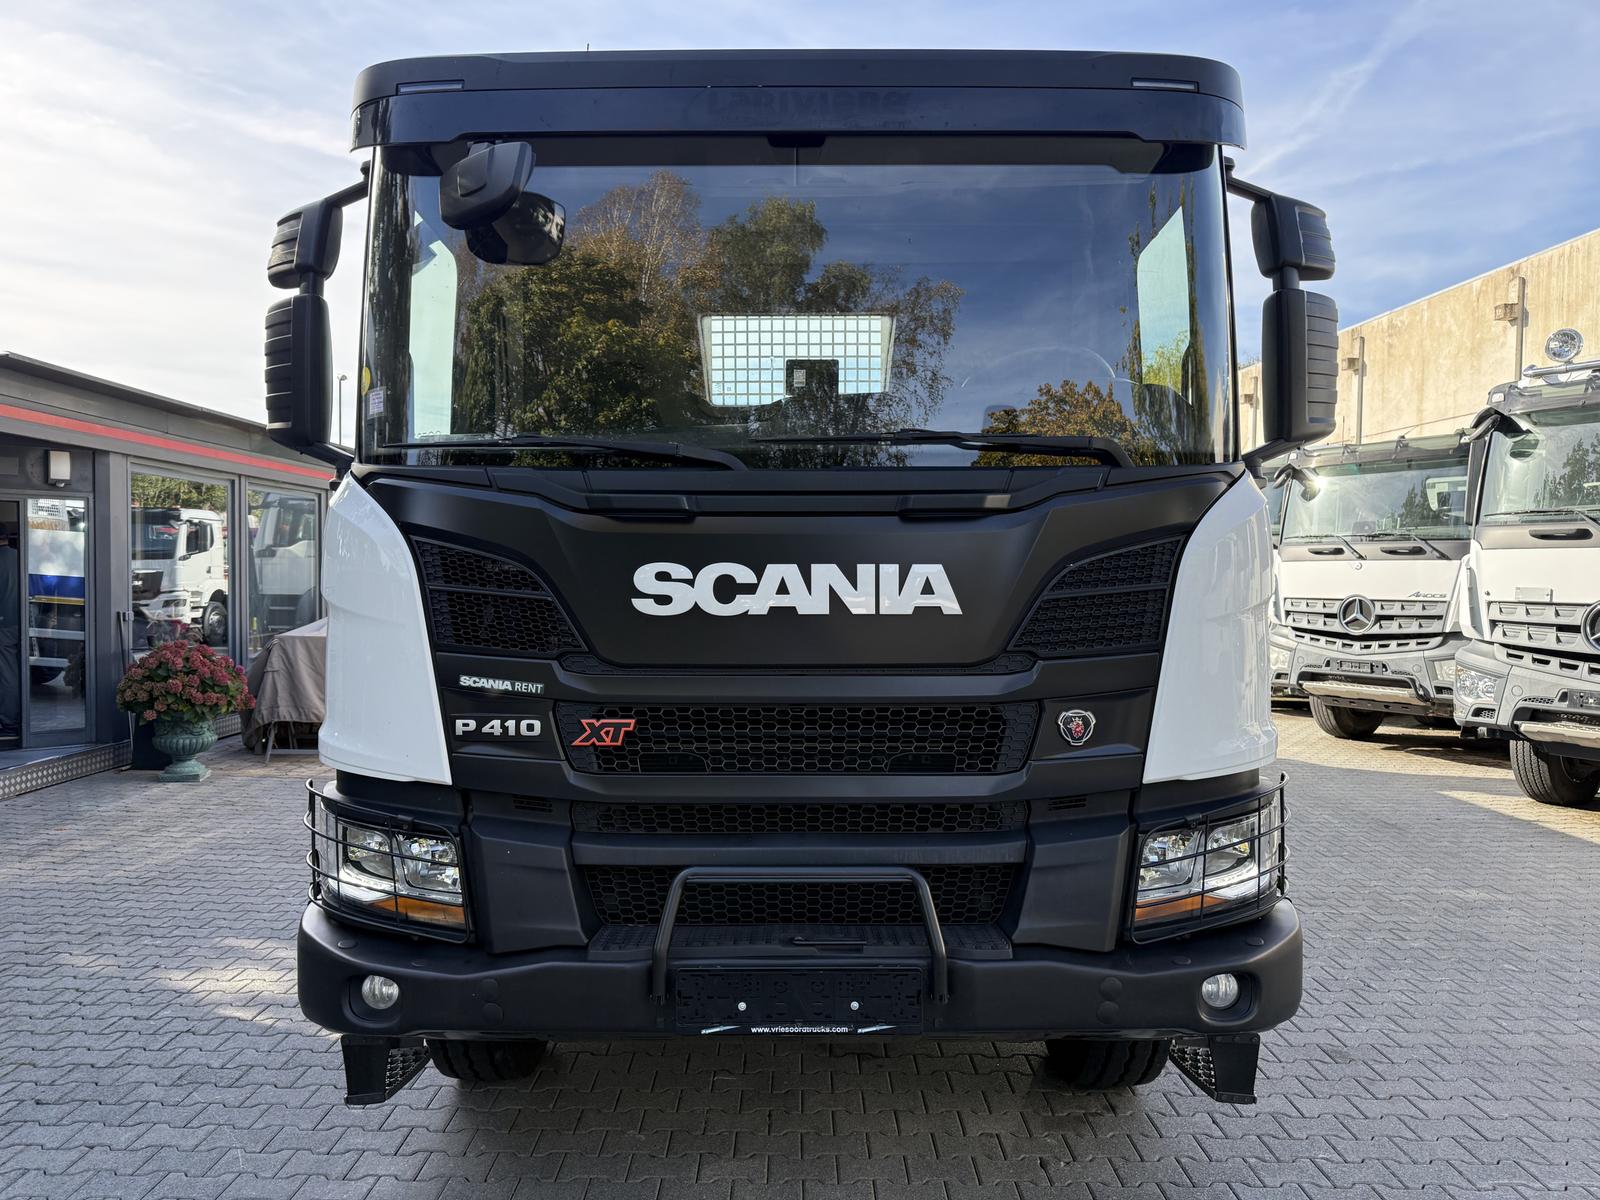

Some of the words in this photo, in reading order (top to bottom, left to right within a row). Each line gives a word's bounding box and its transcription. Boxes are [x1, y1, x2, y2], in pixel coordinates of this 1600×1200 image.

[631, 562, 962, 616] SCANIA
[459, 675, 512, 690] SCANIA
[514, 681, 544, 694] RENT
[455, 719, 477, 736] P
[481, 719, 541, 736] 410
[571, 719, 636, 746] XT
[751, 1025, 849, 1033] www.vriesoordtrucks.com
